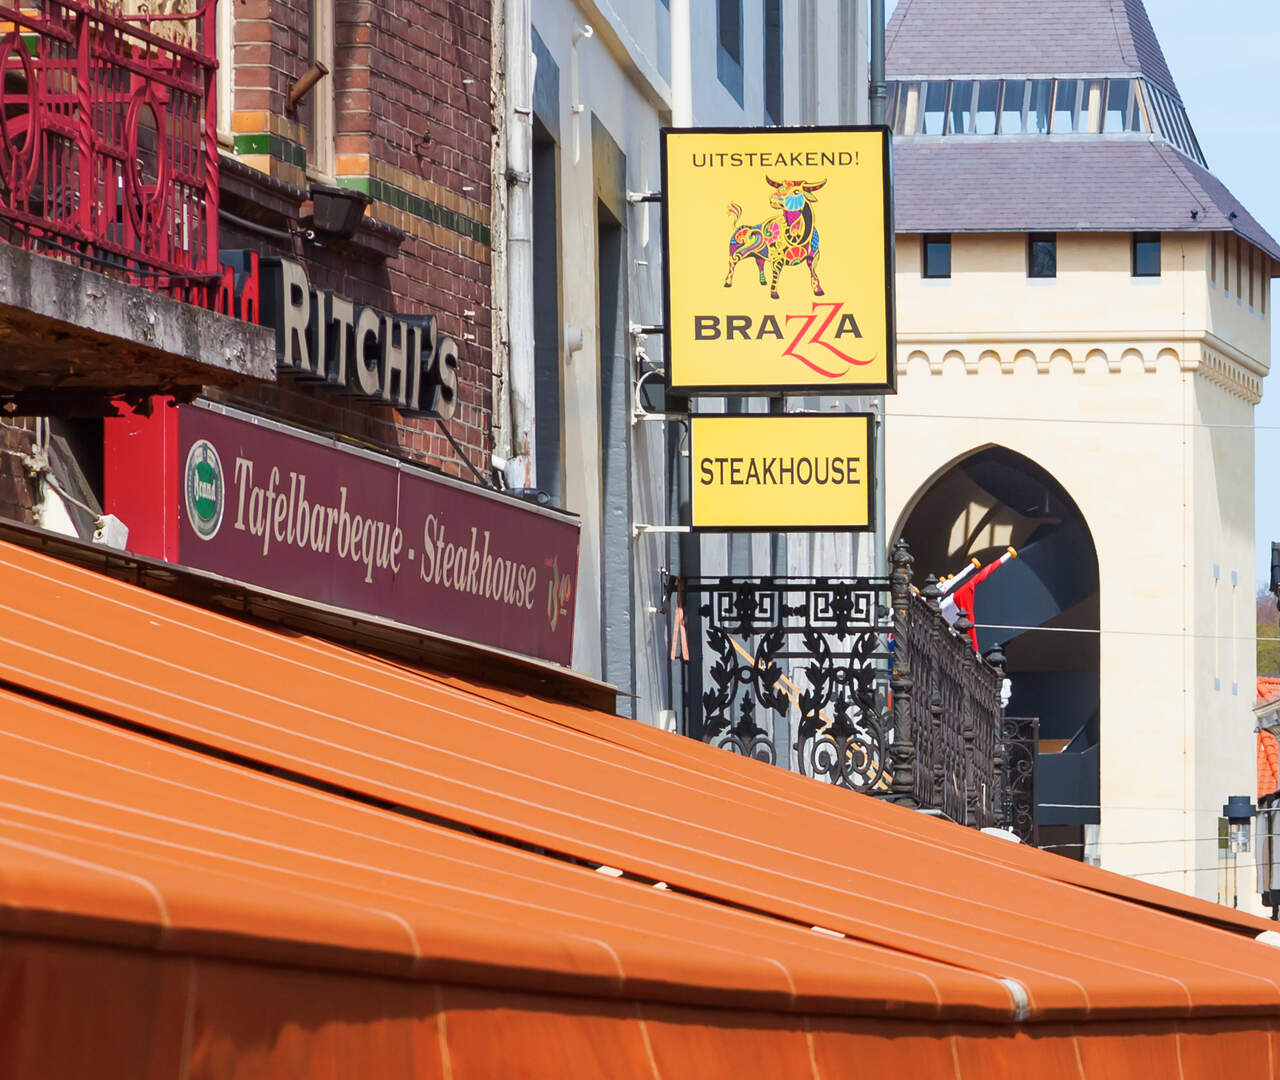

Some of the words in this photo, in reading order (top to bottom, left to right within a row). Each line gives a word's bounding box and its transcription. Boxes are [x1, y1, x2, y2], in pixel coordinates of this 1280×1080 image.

[692, 151, 860, 168] UITSTEAKEND!
[281, 257, 460, 421] RITCHI'S
[694, 301, 878, 379] BRAZZA
[700, 457, 861, 486] STEAKHOUSE
[234, 457, 403, 583] Tafelbarbeque
[420, 514, 537, 610] Steakhouse
